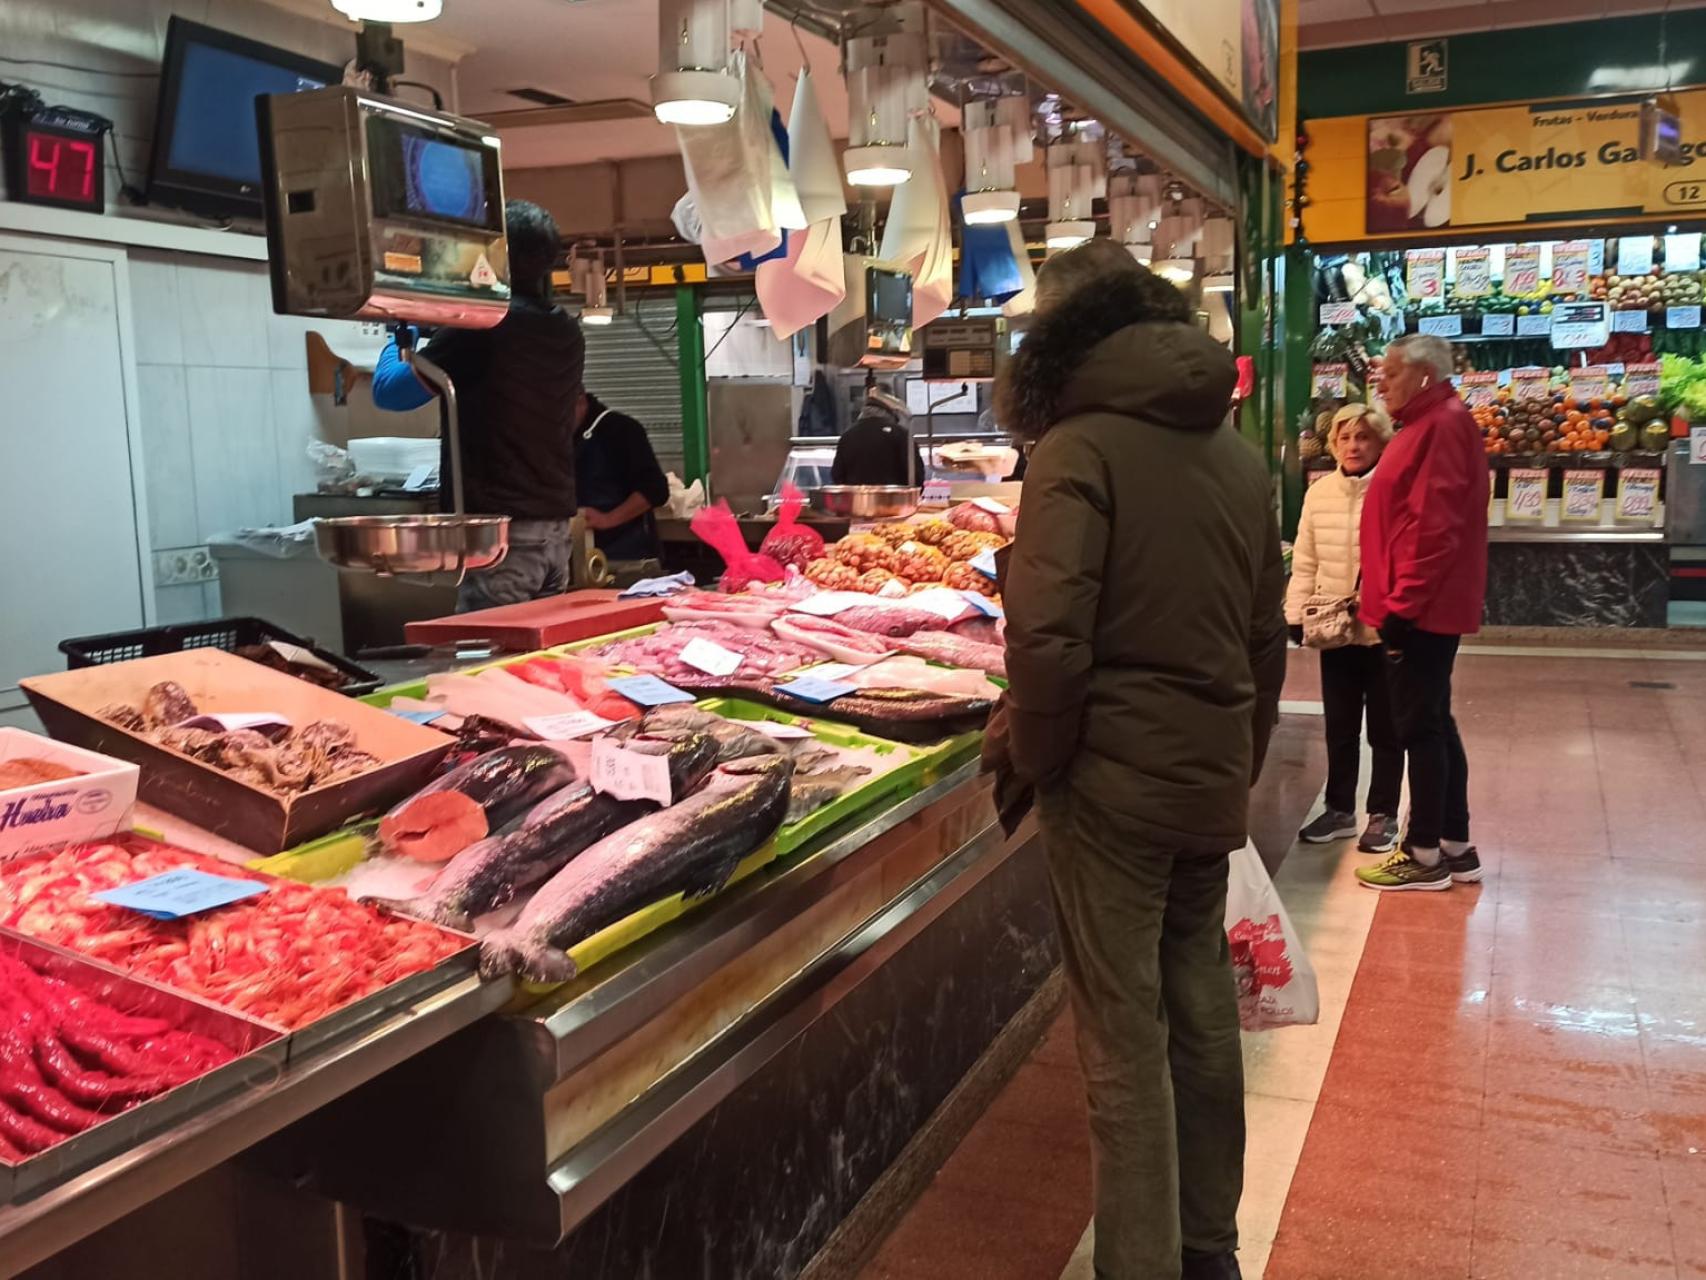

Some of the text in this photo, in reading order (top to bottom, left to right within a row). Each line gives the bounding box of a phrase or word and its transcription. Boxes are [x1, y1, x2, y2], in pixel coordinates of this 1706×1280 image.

[1532, 115, 1573, 127] Frutas
[1587, 109, 1639, 122] Verdura
[30, 138, 95, 196] 47
[1459, 154, 1484, 181] J.
[1495, 147, 1586, 173] Carlos
[1679, 185, 1701, 200] 12
